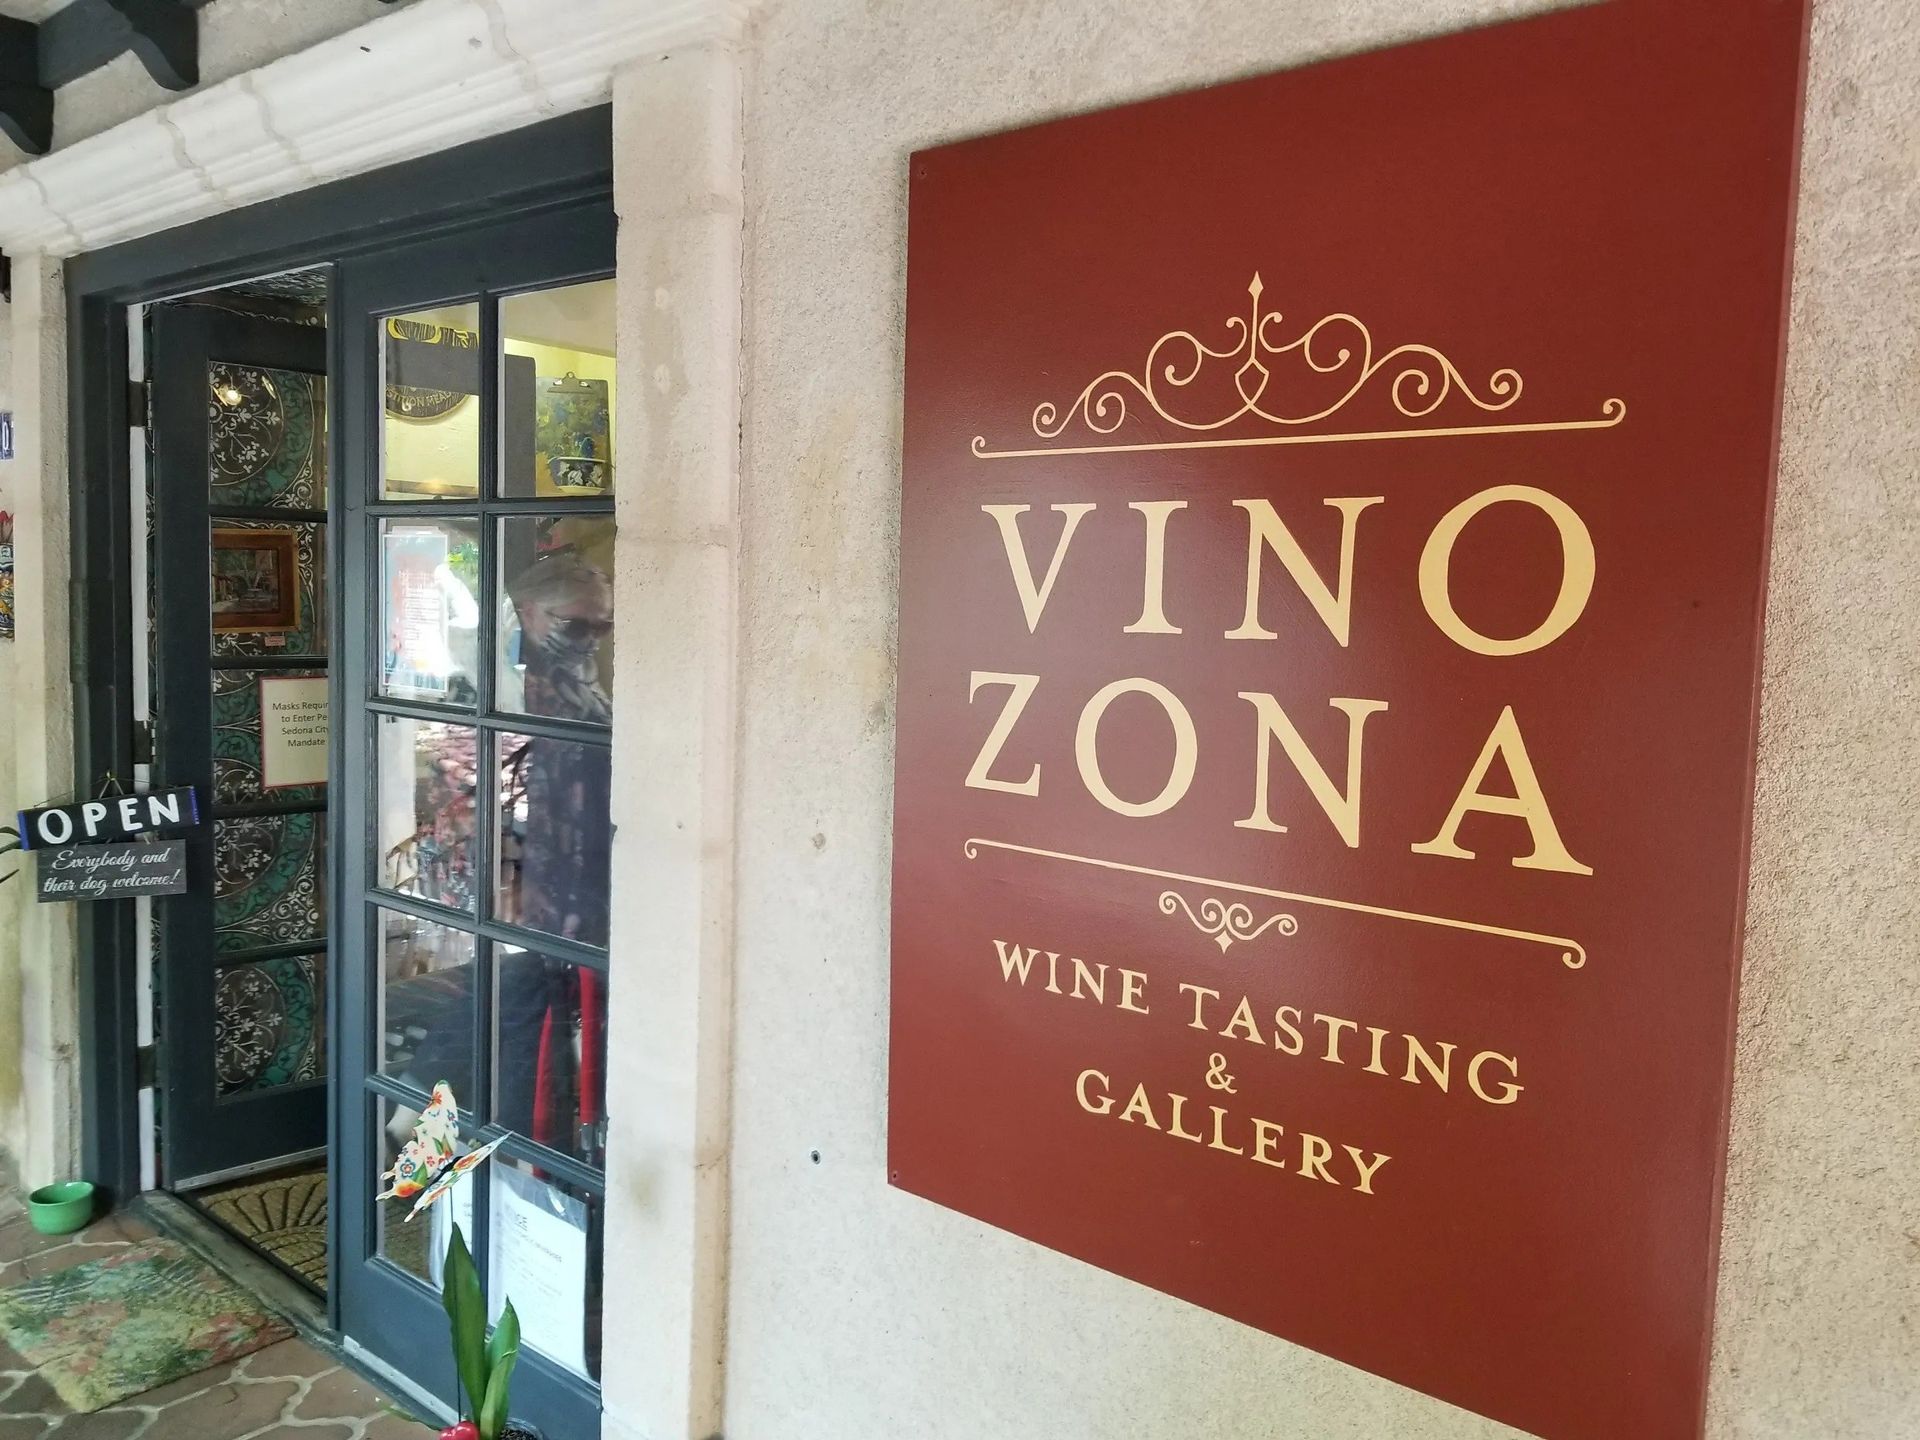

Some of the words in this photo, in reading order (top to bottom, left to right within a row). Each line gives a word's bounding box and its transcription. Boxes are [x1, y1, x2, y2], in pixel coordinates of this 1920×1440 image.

[980, 485, 1596, 657] VINO
[272, 702, 300, 711] Masks
[281, 727, 313, 735] Sedona
[288, 739, 326, 747] Mandate
[964, 670, 1594, 876] ZONA
[37, 793, 180, 844] OPEN
[52, 850, 137, 874] Everybody
[141, 848, 171, 864] and
[43, 876, 76, 893] their
[80, 876, 108, 896] dog
[113, 869, 181, 888] welcome!
[992, 939, 1150, 1015] WINE
[1179, 982, 1525, 1105] TASTING
[1206, 1053, 1238, 1094] &
[1075, 1069, 1392, 1195] GALLERY
